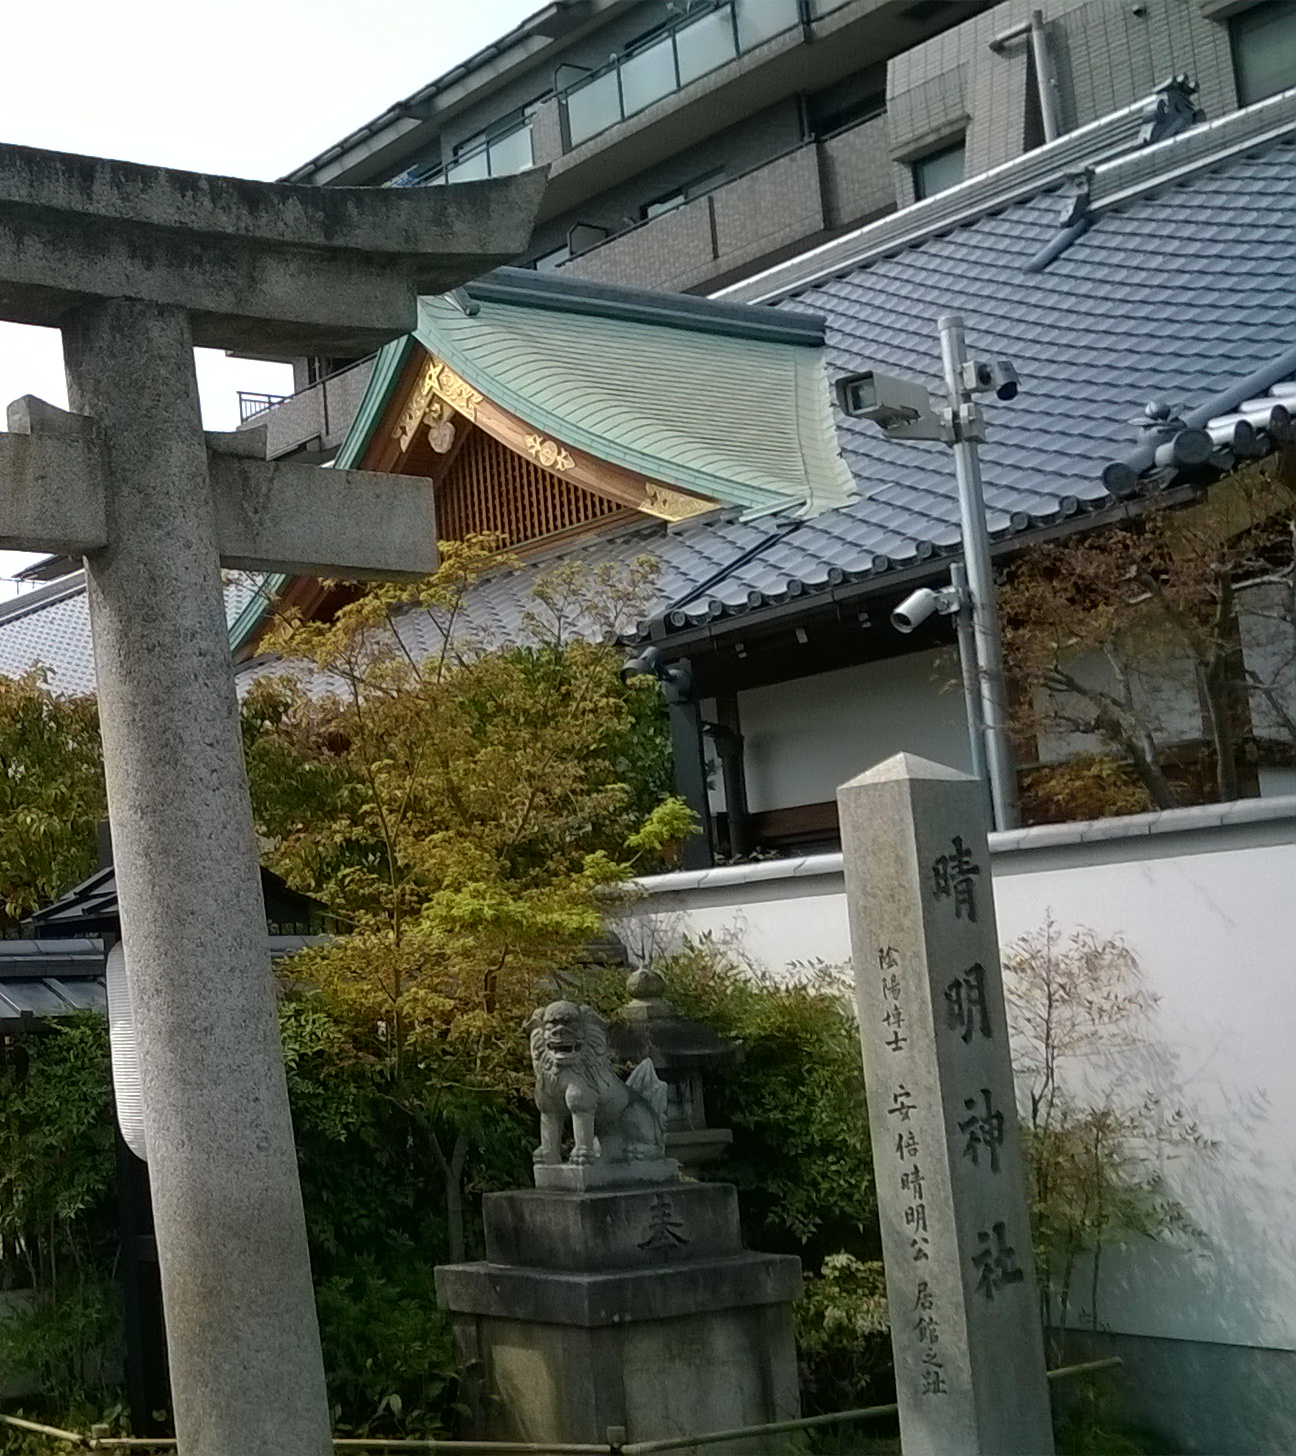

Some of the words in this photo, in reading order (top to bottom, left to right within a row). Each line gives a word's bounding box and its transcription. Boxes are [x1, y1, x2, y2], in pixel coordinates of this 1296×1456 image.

[887, 1083, 930, 1262] 安倍晴明公
[931, 835, 1023, 1301] 晴明神社
